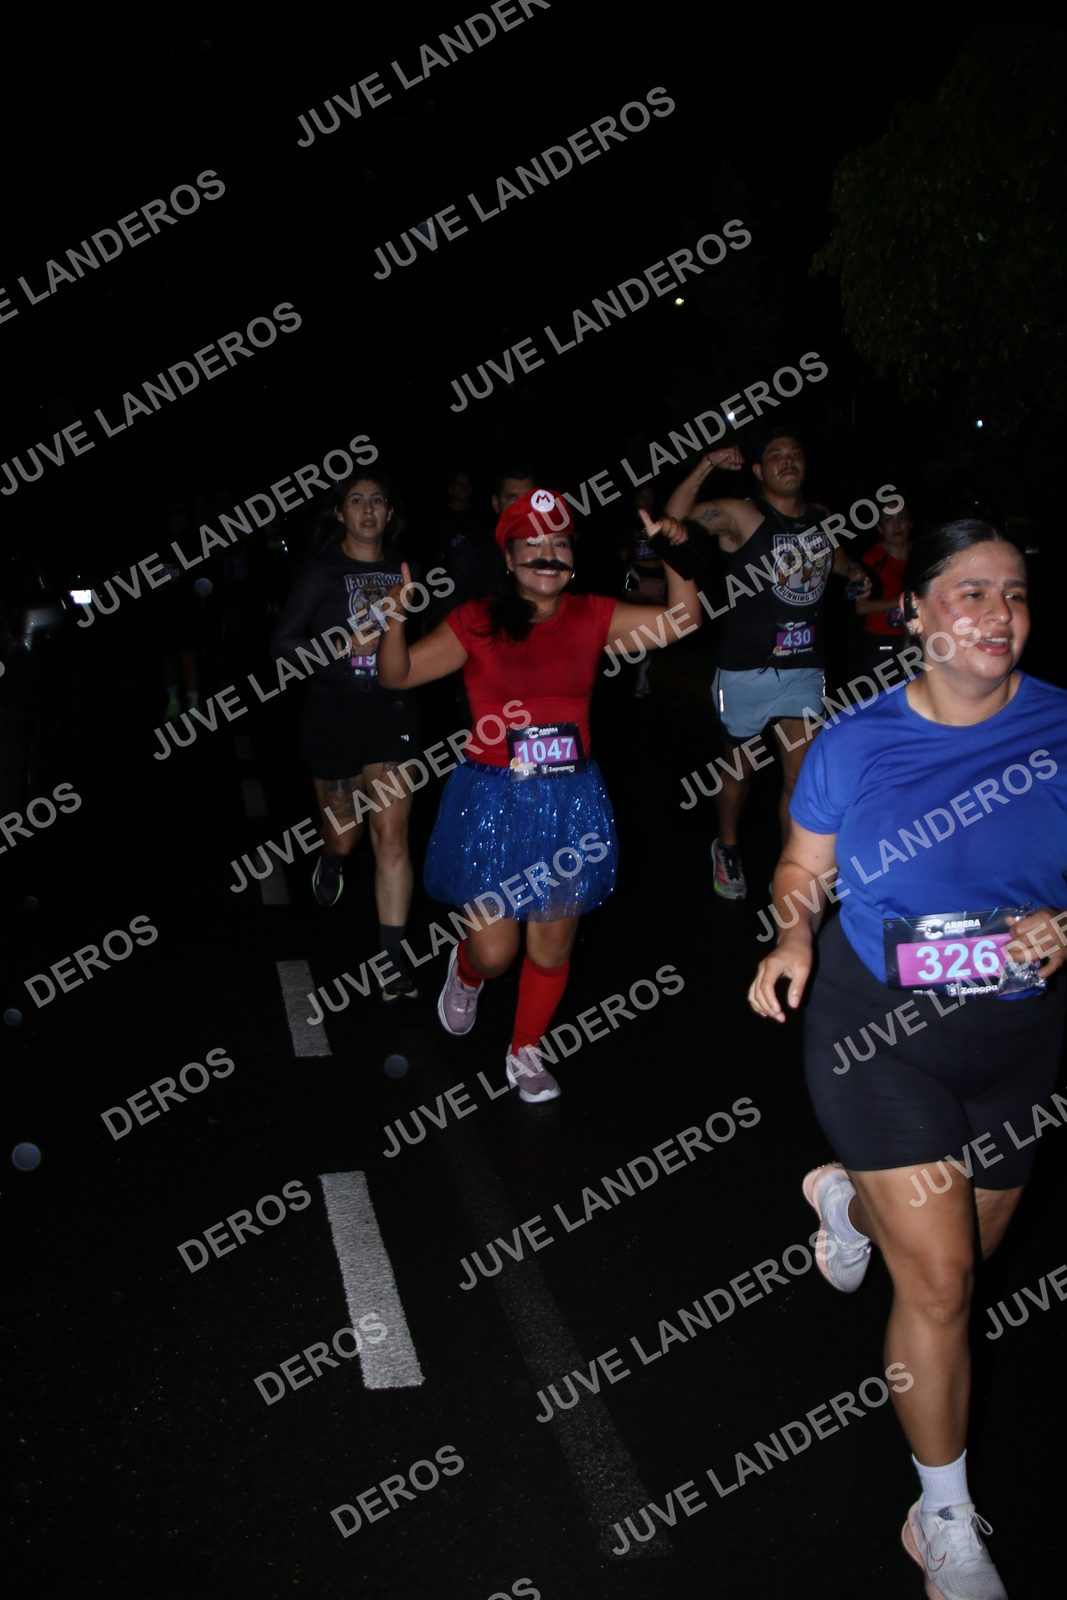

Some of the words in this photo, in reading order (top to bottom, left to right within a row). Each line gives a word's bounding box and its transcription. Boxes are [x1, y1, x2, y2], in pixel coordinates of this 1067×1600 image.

[782, 629, 811, 647] 430
[518, 737, 574, 764] 1047
[915, 939, 1000, 982] 326
